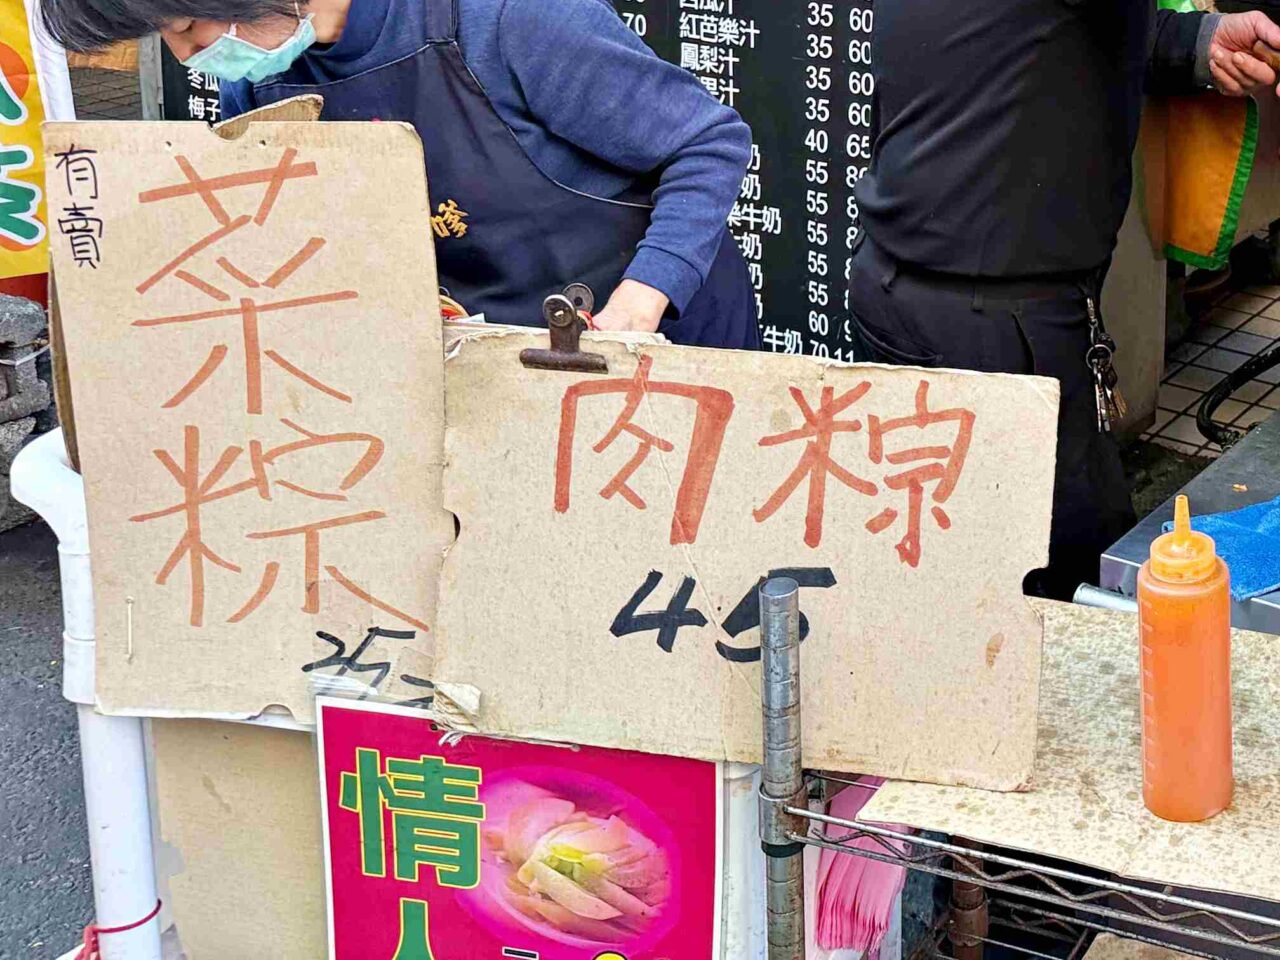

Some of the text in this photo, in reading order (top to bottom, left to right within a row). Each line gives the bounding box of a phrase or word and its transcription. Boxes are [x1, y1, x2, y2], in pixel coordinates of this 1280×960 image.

[622, 12, 647, 37] 70
[679, 11, 761, 49] 紅芭樂汁
[807, 2, 874, 33] 35 60
[680, 42, 740, 76] 鳳梨汁
[806, 34, 872, 65] 35 60
[187, 67, 220, 93] 冬瓜
[692, 76, 740, 107] 果汁
[805, 66, 875, 96] 35 60
[187, 94, 221, 122] 梅子
[805, 97, 871, 128] 35 60
[804, 128, 871, 159] 40 65
[806, 159, 828, 184] 55
[54, 142, 103, 270] 有賣
[806, 190, 828, 215] 55
[807, 220, 828, 246] 55
[808, 250, 828, 276] 55
[808, 281, 828, 307] 55
[809, 310, 829, 336] 60
[809, 339, 829, 359] 70
[129, 147, 430, 632] 菜粽
[554, 353, 976, 568] 肉粽
[609, 566, 837, 662] 45
